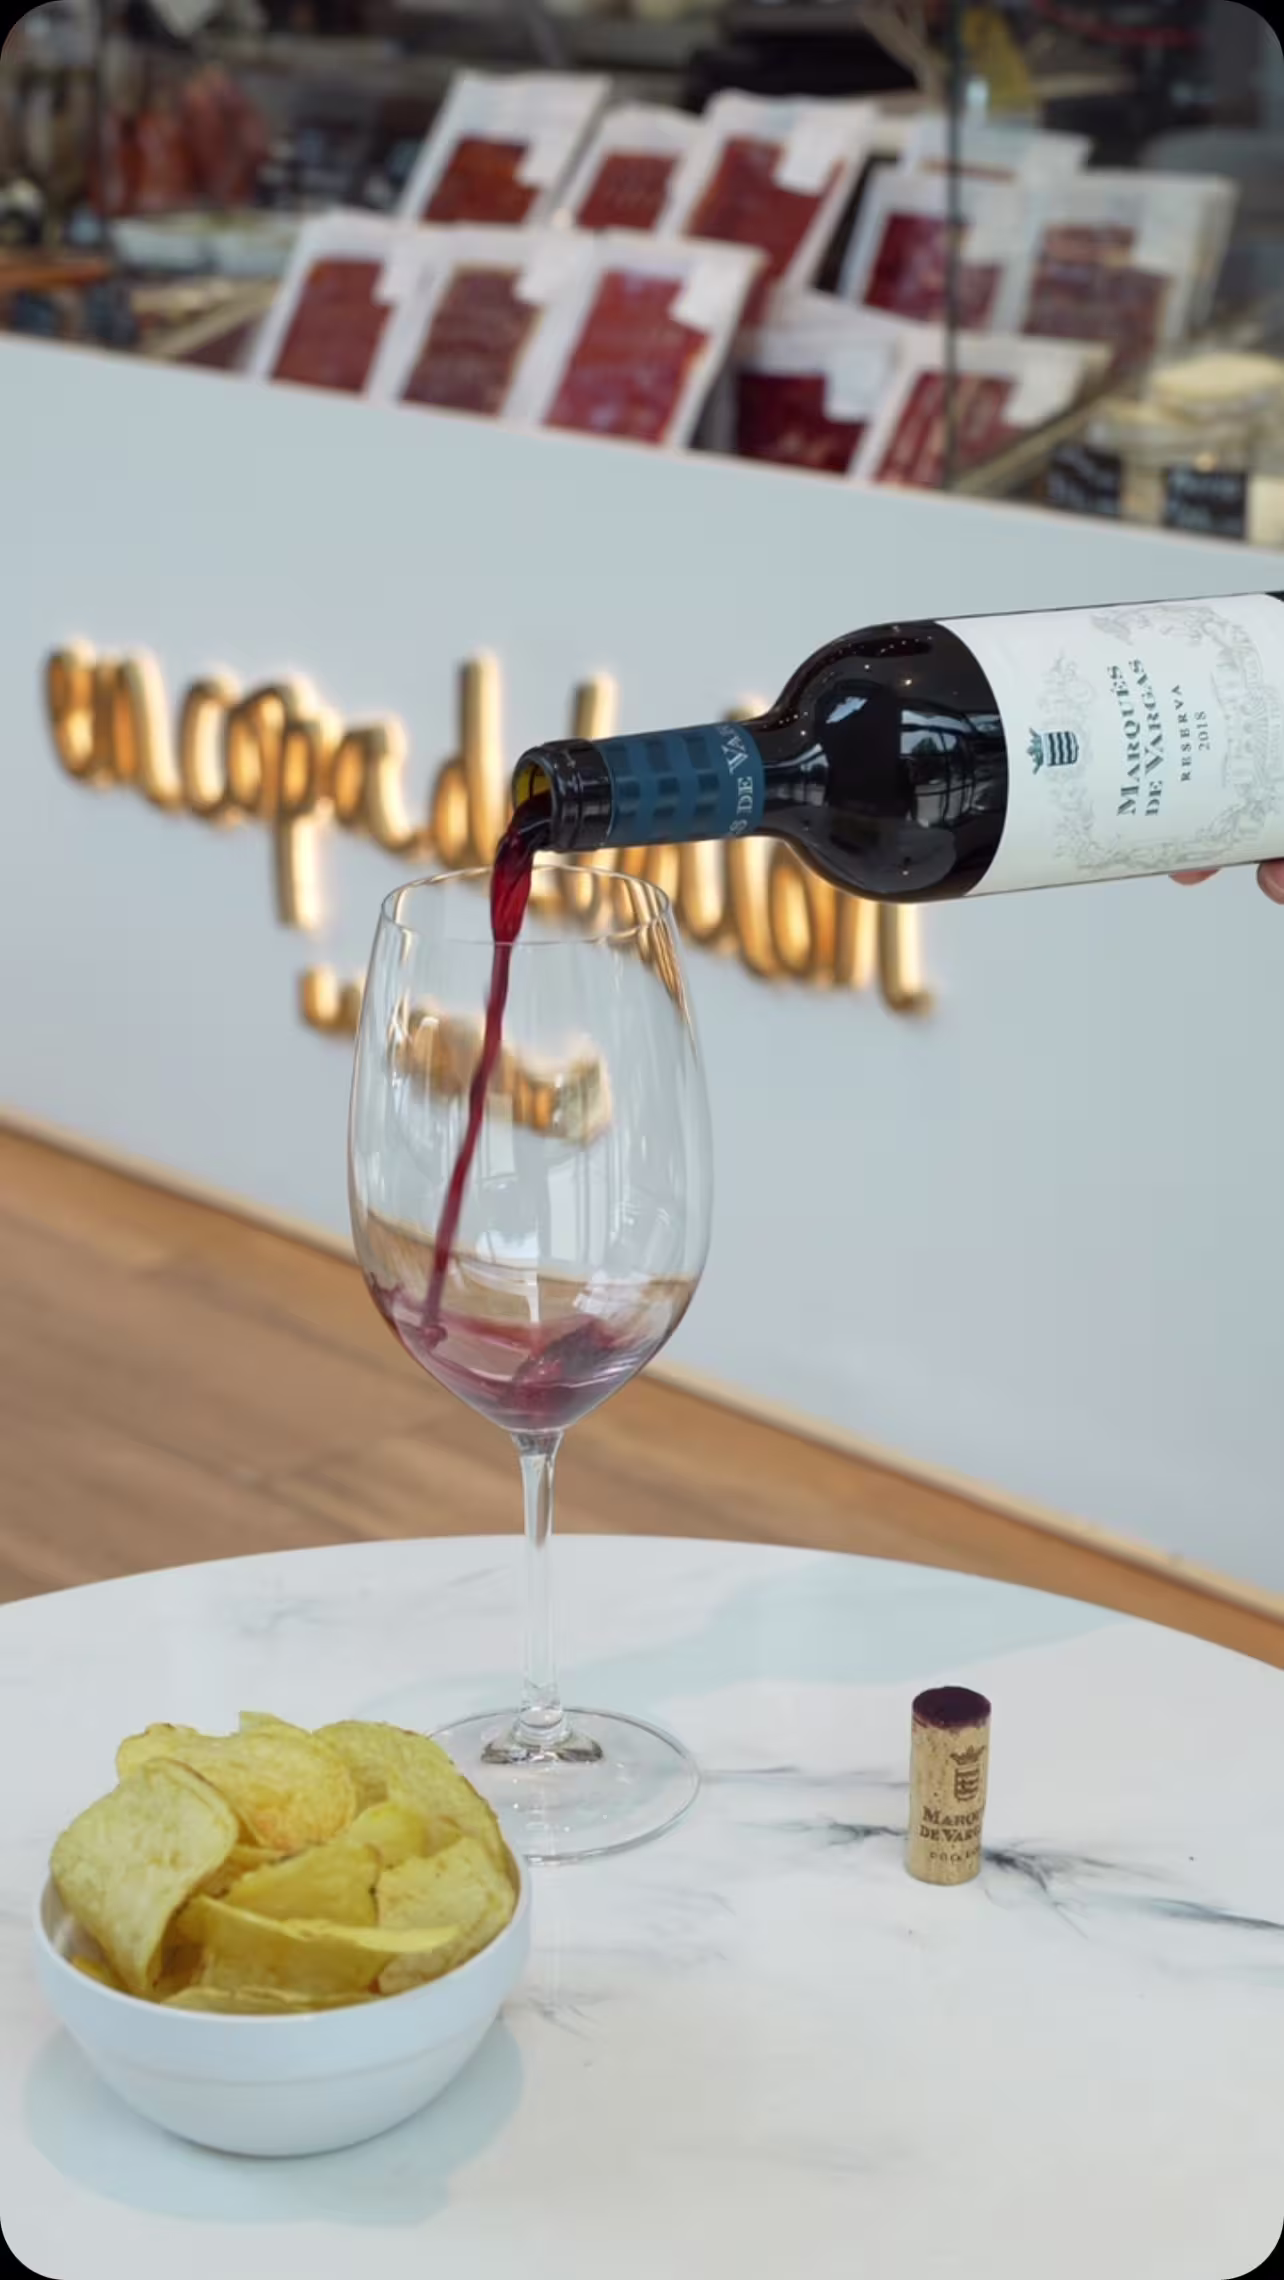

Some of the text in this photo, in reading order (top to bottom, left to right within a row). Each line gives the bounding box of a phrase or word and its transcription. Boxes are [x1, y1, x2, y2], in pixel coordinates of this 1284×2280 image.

[1128, 658, 1164, 816] DE VARGAS
[1171, 684, 1191, 782] RESERVA
[1195, 710, 1210, 751] 2018
[737, 776, 753, 815] DE
[920, 1825, 940, 1841] DE
